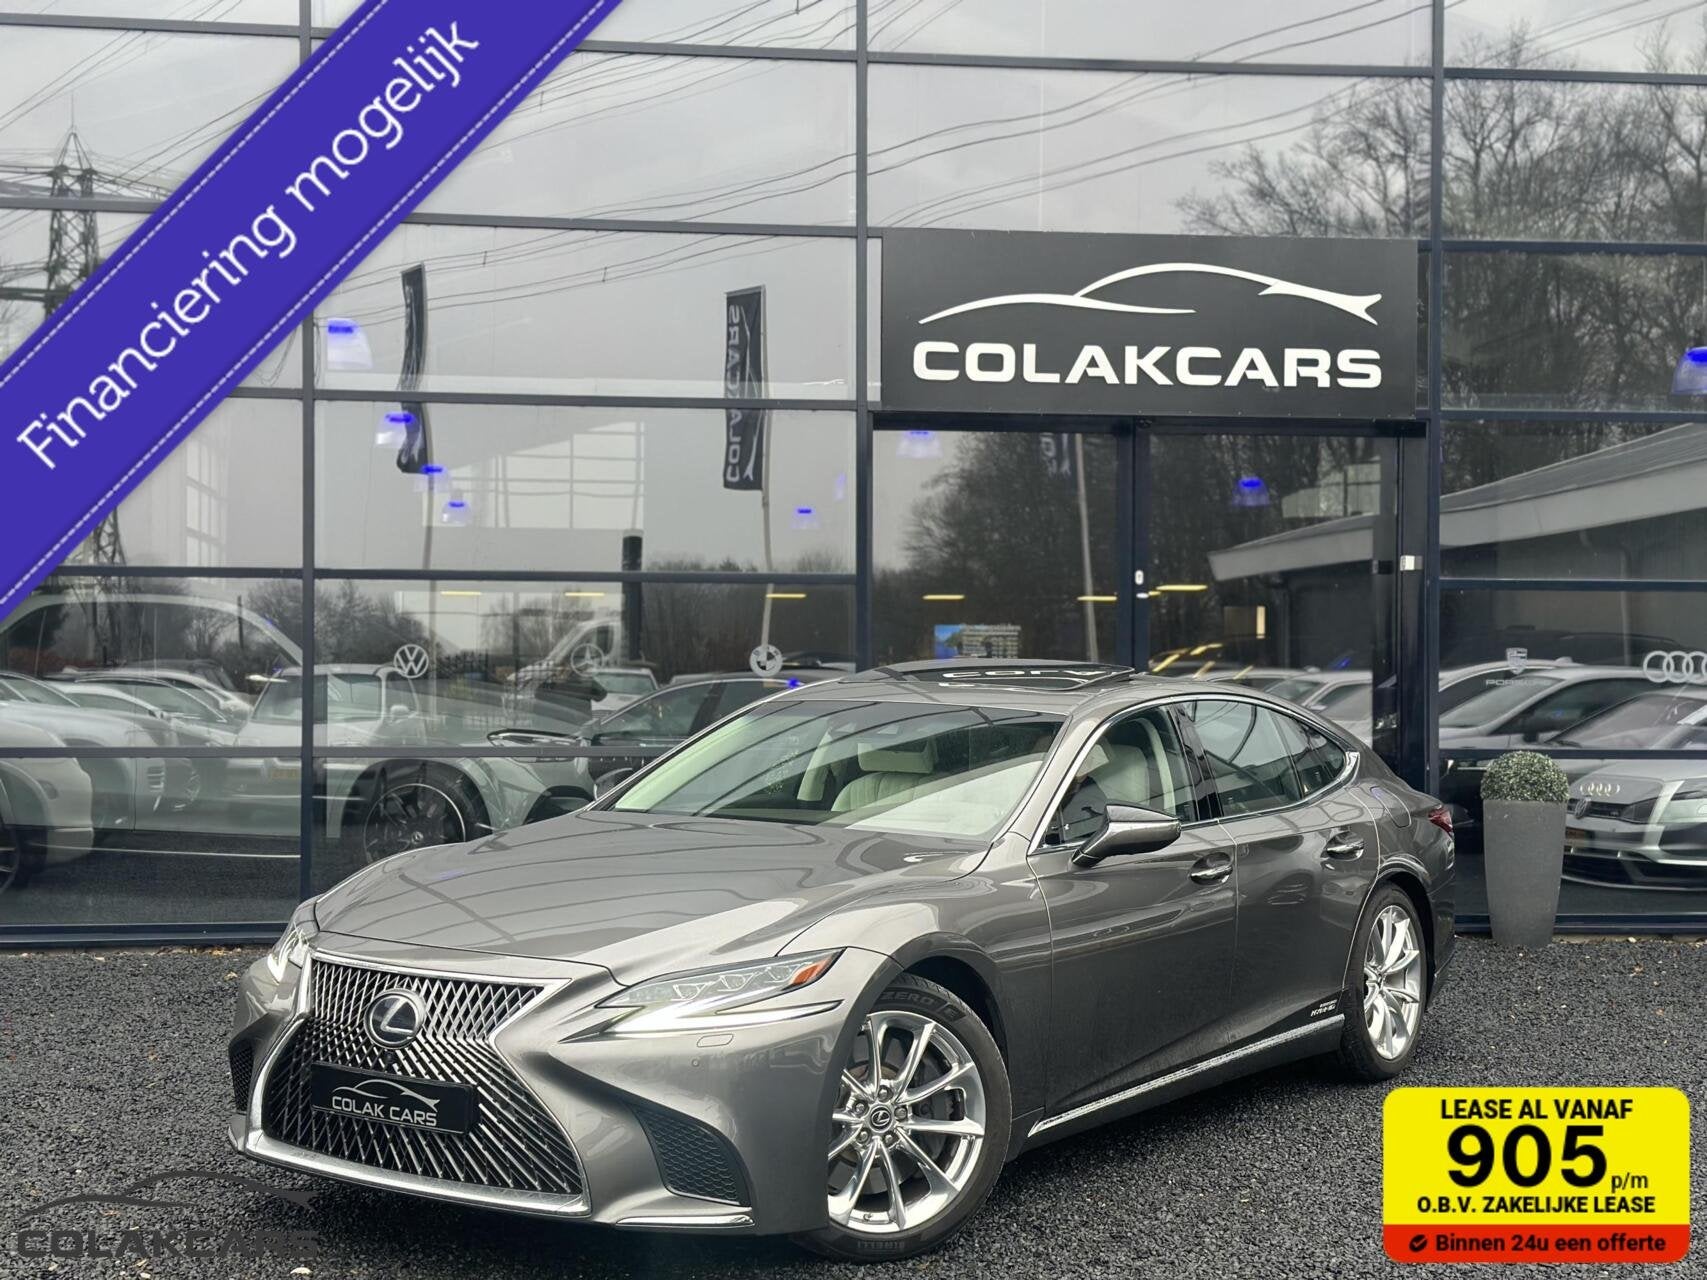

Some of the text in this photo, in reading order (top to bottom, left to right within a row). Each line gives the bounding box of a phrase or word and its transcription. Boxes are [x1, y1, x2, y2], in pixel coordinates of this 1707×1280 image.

[913, 341, 1382, 388] COLAKCARS
[332, 1096, 437, 1126] COLAK CARS
